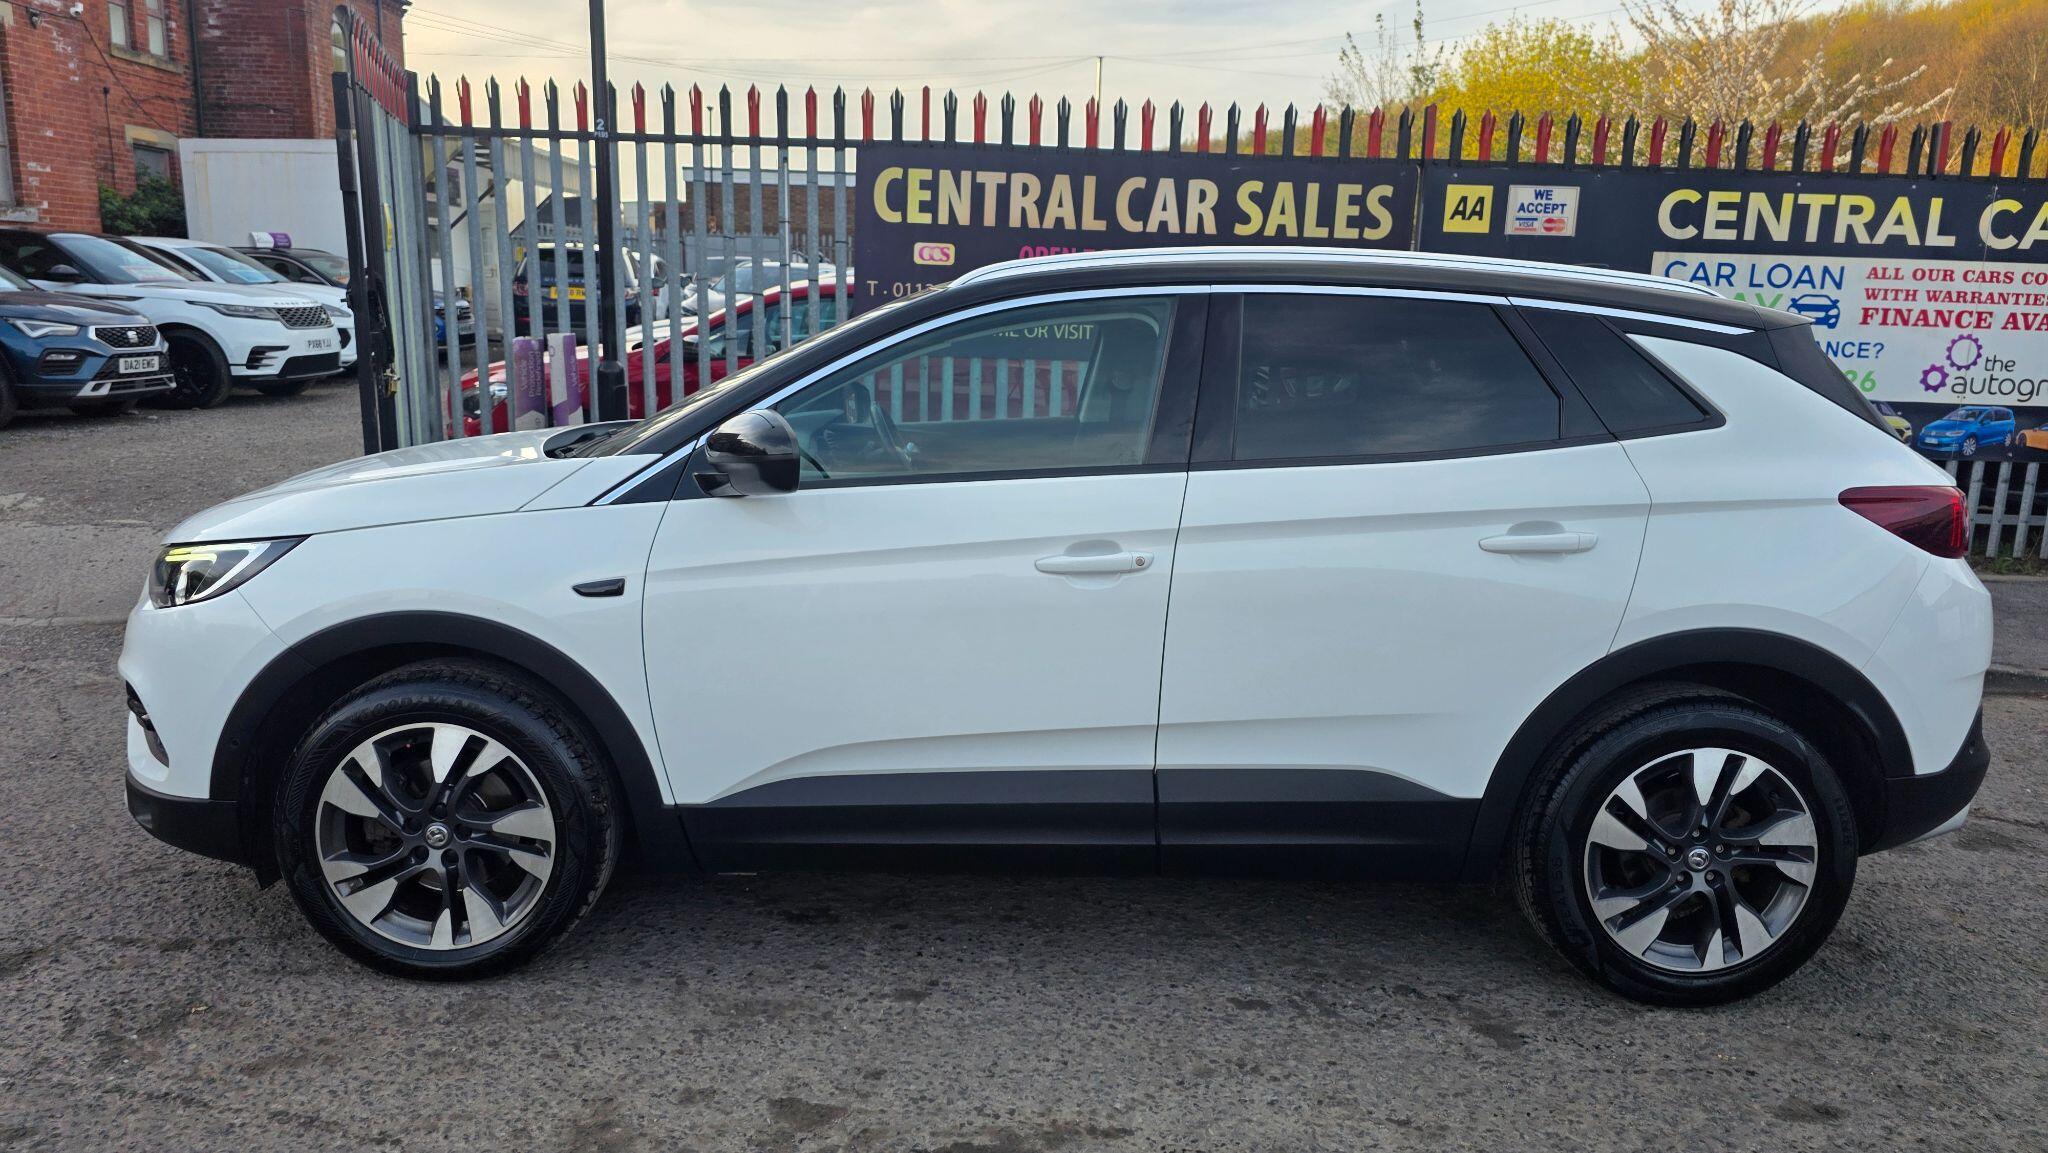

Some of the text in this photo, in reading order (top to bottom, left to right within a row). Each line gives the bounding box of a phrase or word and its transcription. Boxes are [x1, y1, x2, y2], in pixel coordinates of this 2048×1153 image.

[873, 167, 1395, 240] CENTRAL CAR SALES
[1534, 189, 1554, 201] WE
[1449, 195, 1485, 221] AA
[1517, 202, 1567, 215] ACCEPT
[1658, 188, 2048, 250] CENTRAL CA
[1664, 260, 1845, 290] CAR LOAN
[1866, 267, 1905, 281] ALL
[1911, 267, 1956, 283] OUR
[1962, 269, 2015, 285] CARS
[1864, 287, 2048, 307] WITH WARRANTIE
[1859, 307, 1994, 330] FINANCE
[1053, 324, 1095, 340] VISIT
[1815, 340, 1885, 359] NCE?
[1984, 354, 2016, 373] the
[1950, 373, 2048, 403] autogr
